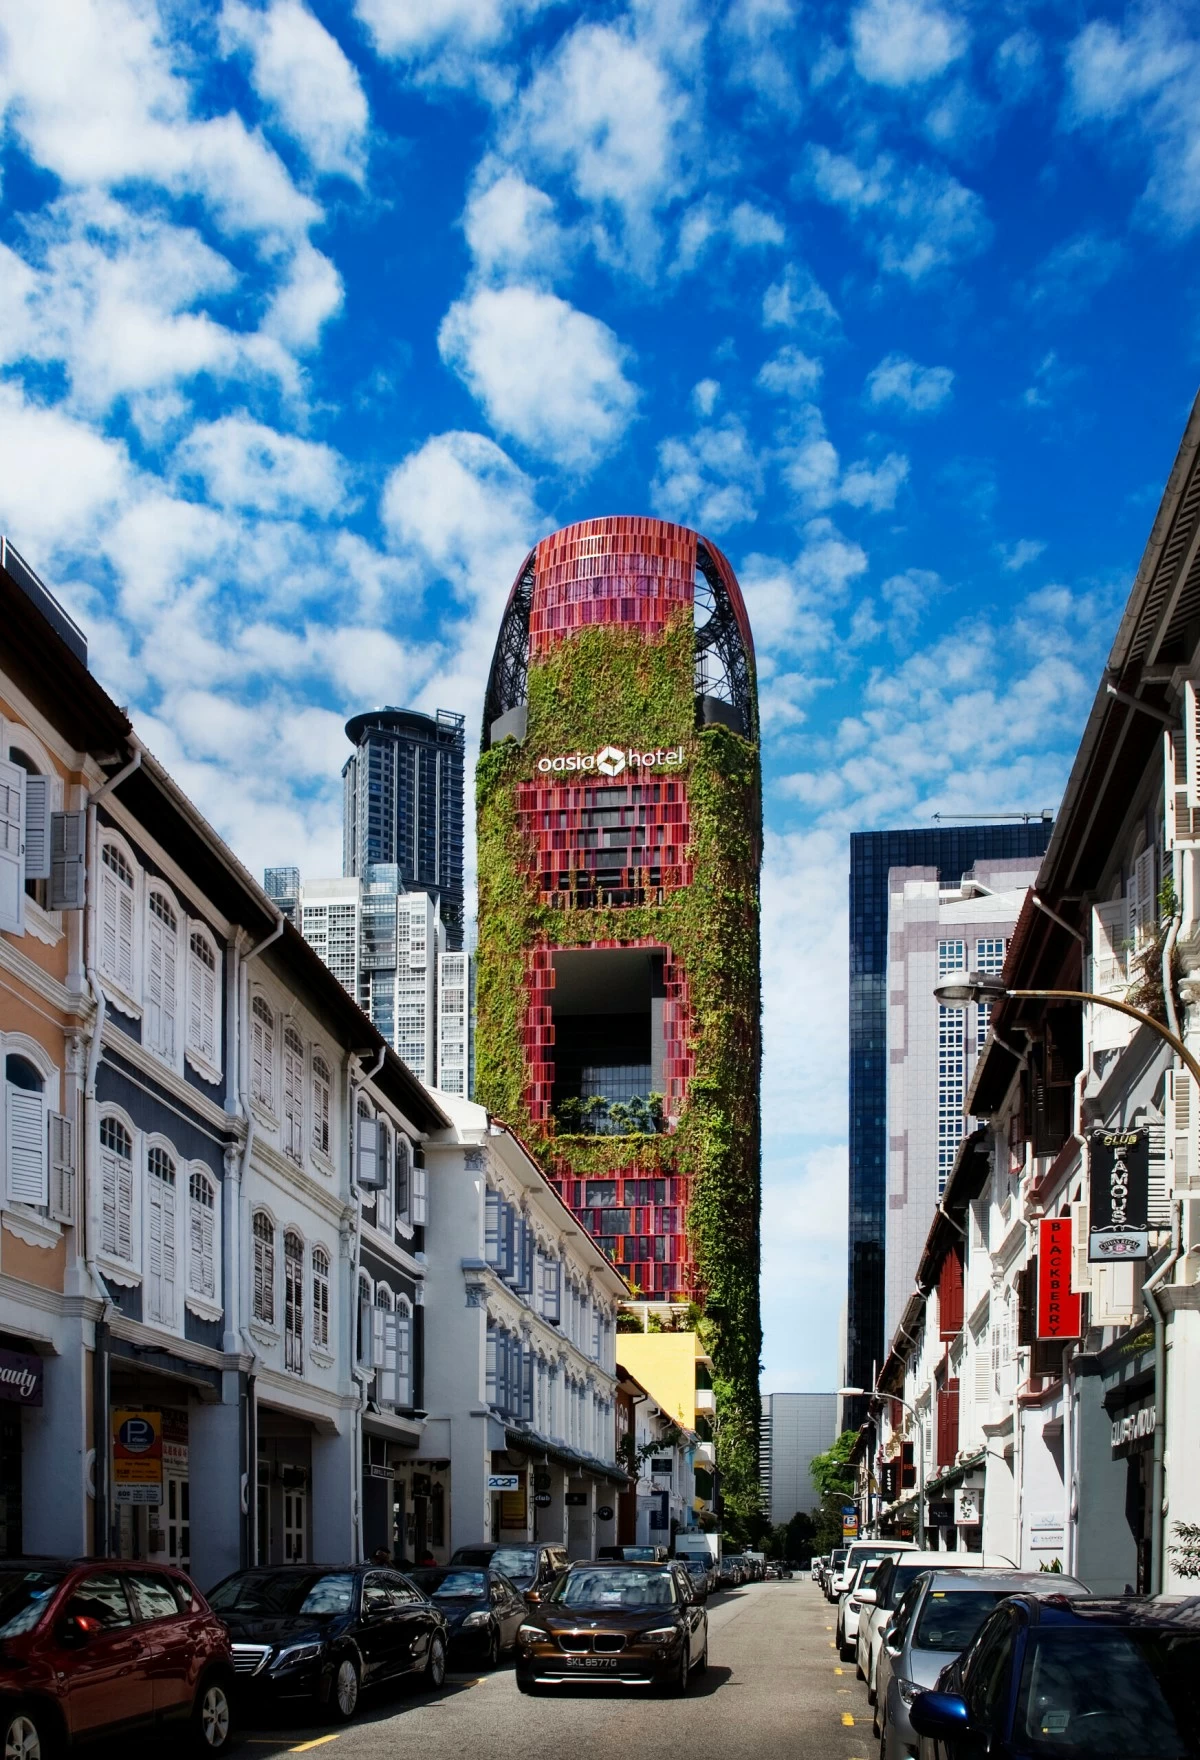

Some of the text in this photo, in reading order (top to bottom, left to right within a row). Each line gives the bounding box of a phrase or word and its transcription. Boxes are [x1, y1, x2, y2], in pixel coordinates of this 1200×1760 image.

[537, 745, 684, 772] oasia hotel
[1103, 1134, 1138, 1146] CLUB
[1110, 1146, 1129, 1224] FAMOUS
[1100, 1239, 1120, 1249] CHIVAS
[1048, 1221, 1062, 1336] BLACKBERRY
[127, 1420, 148, 1443] P
[488, 1477, 518, 1487] 2C2P
[534, 1493, 551, 1501] club
